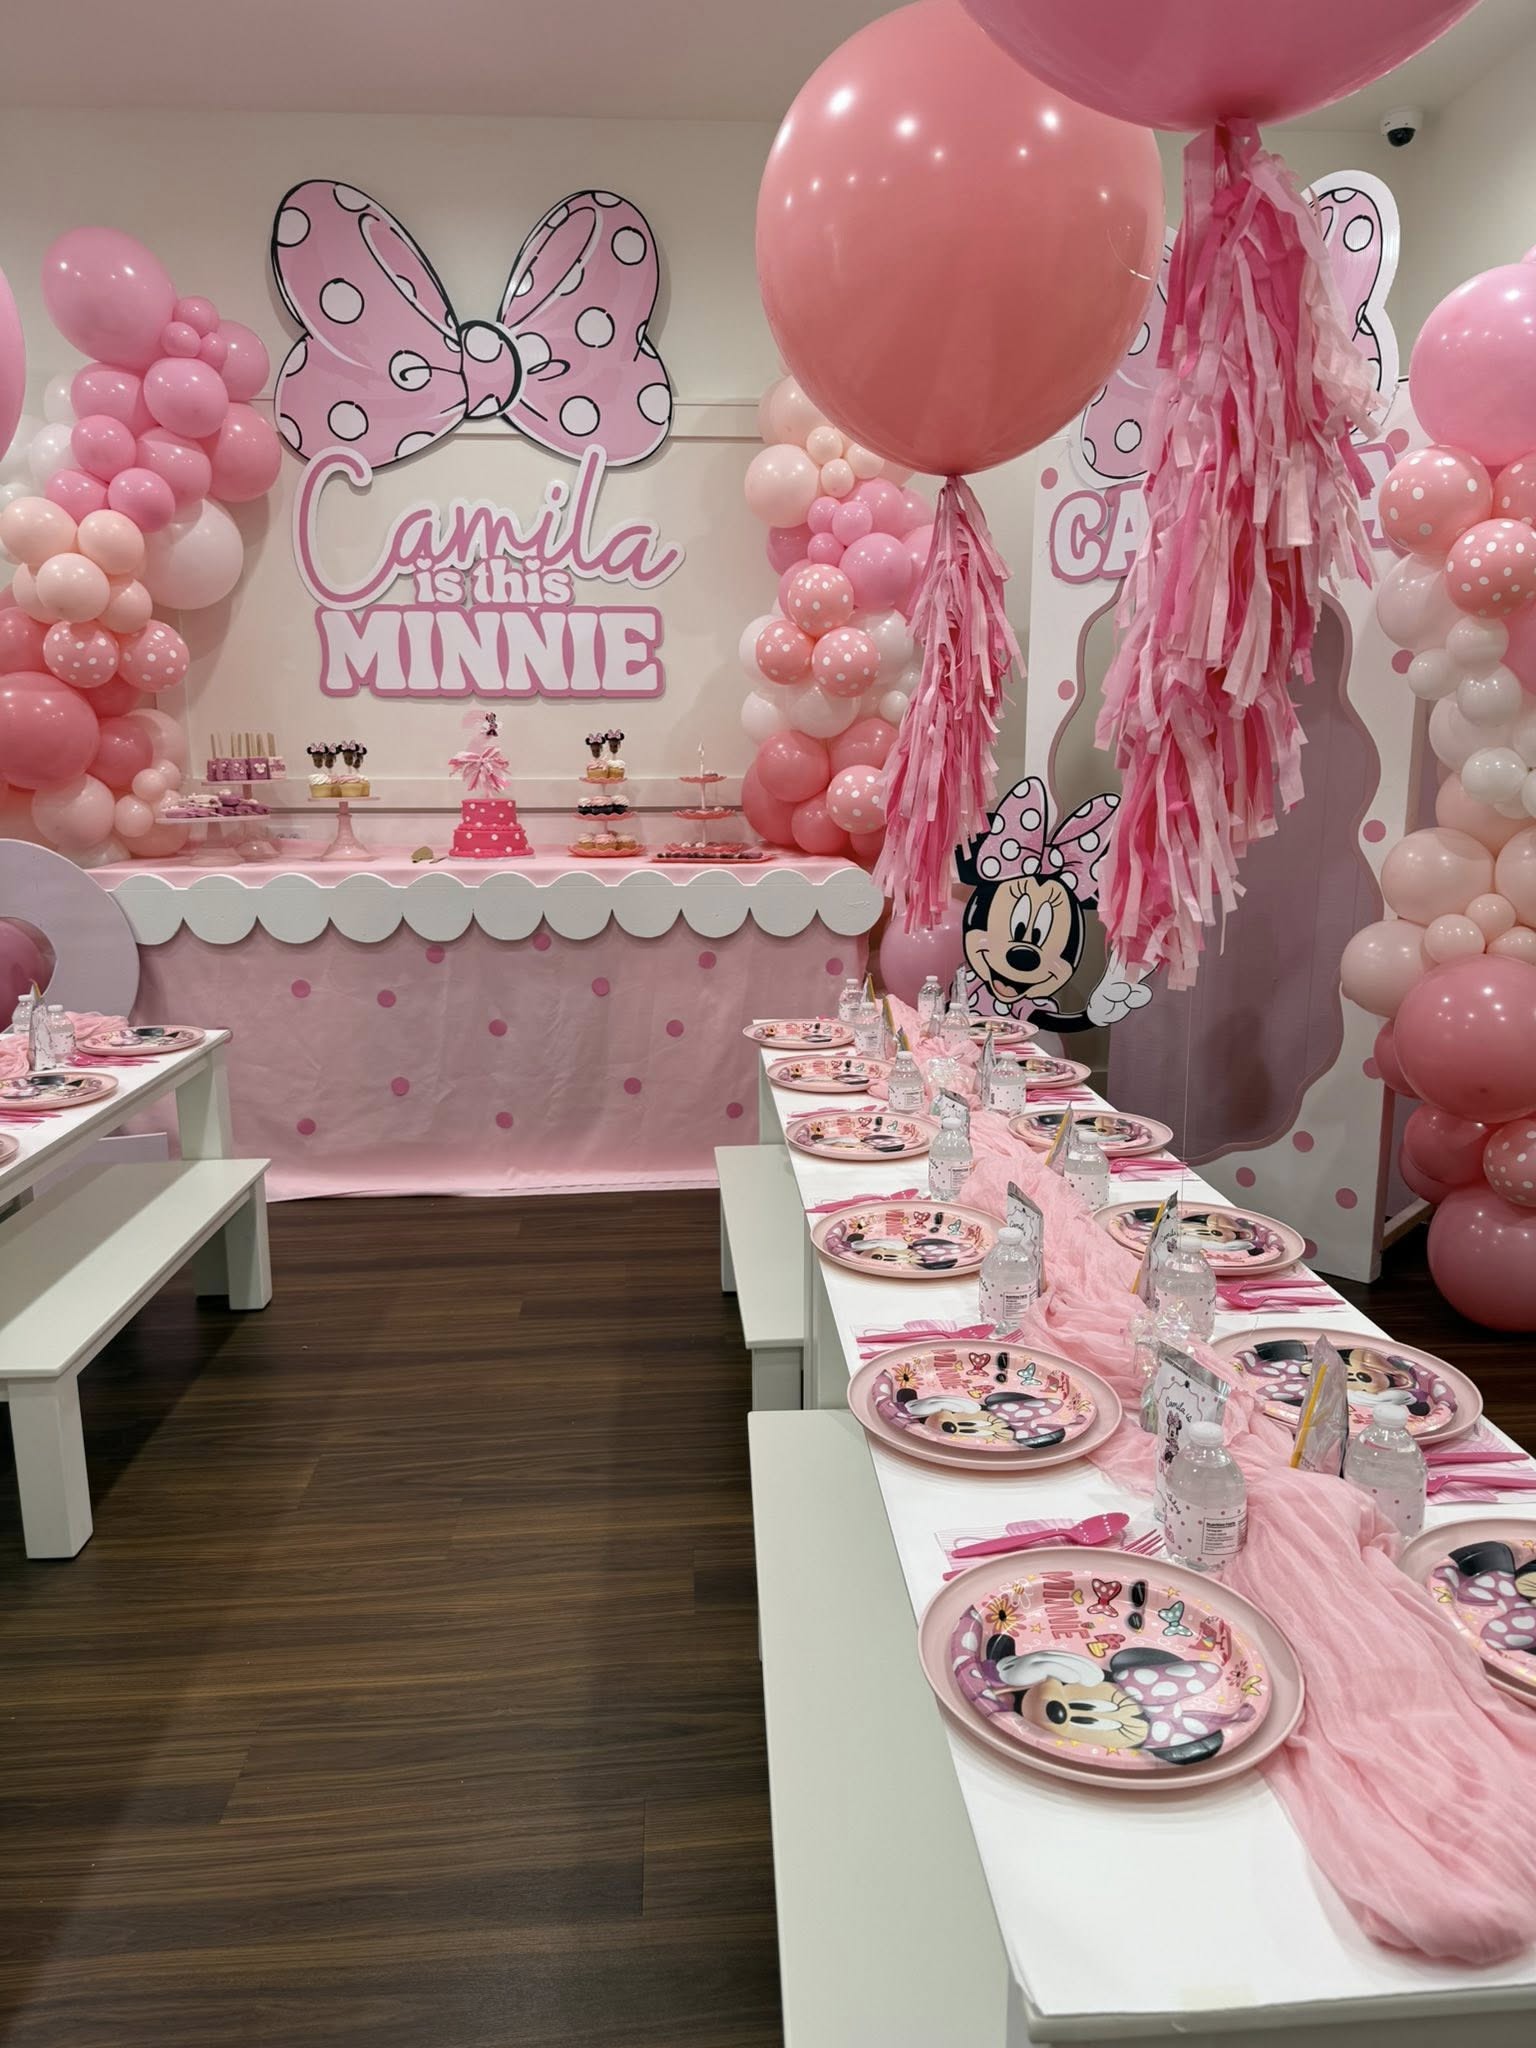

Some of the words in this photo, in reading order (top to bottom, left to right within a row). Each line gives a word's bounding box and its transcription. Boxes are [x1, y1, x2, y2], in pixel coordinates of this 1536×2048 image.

[295, 446, 683, 608] Camila
[415, 556, 465, 604] is
[472, 556, 573, 604] this
[316, 606, 663, 696] MINNIE
[1040, 1571, 1090, 1640] MINNIE
